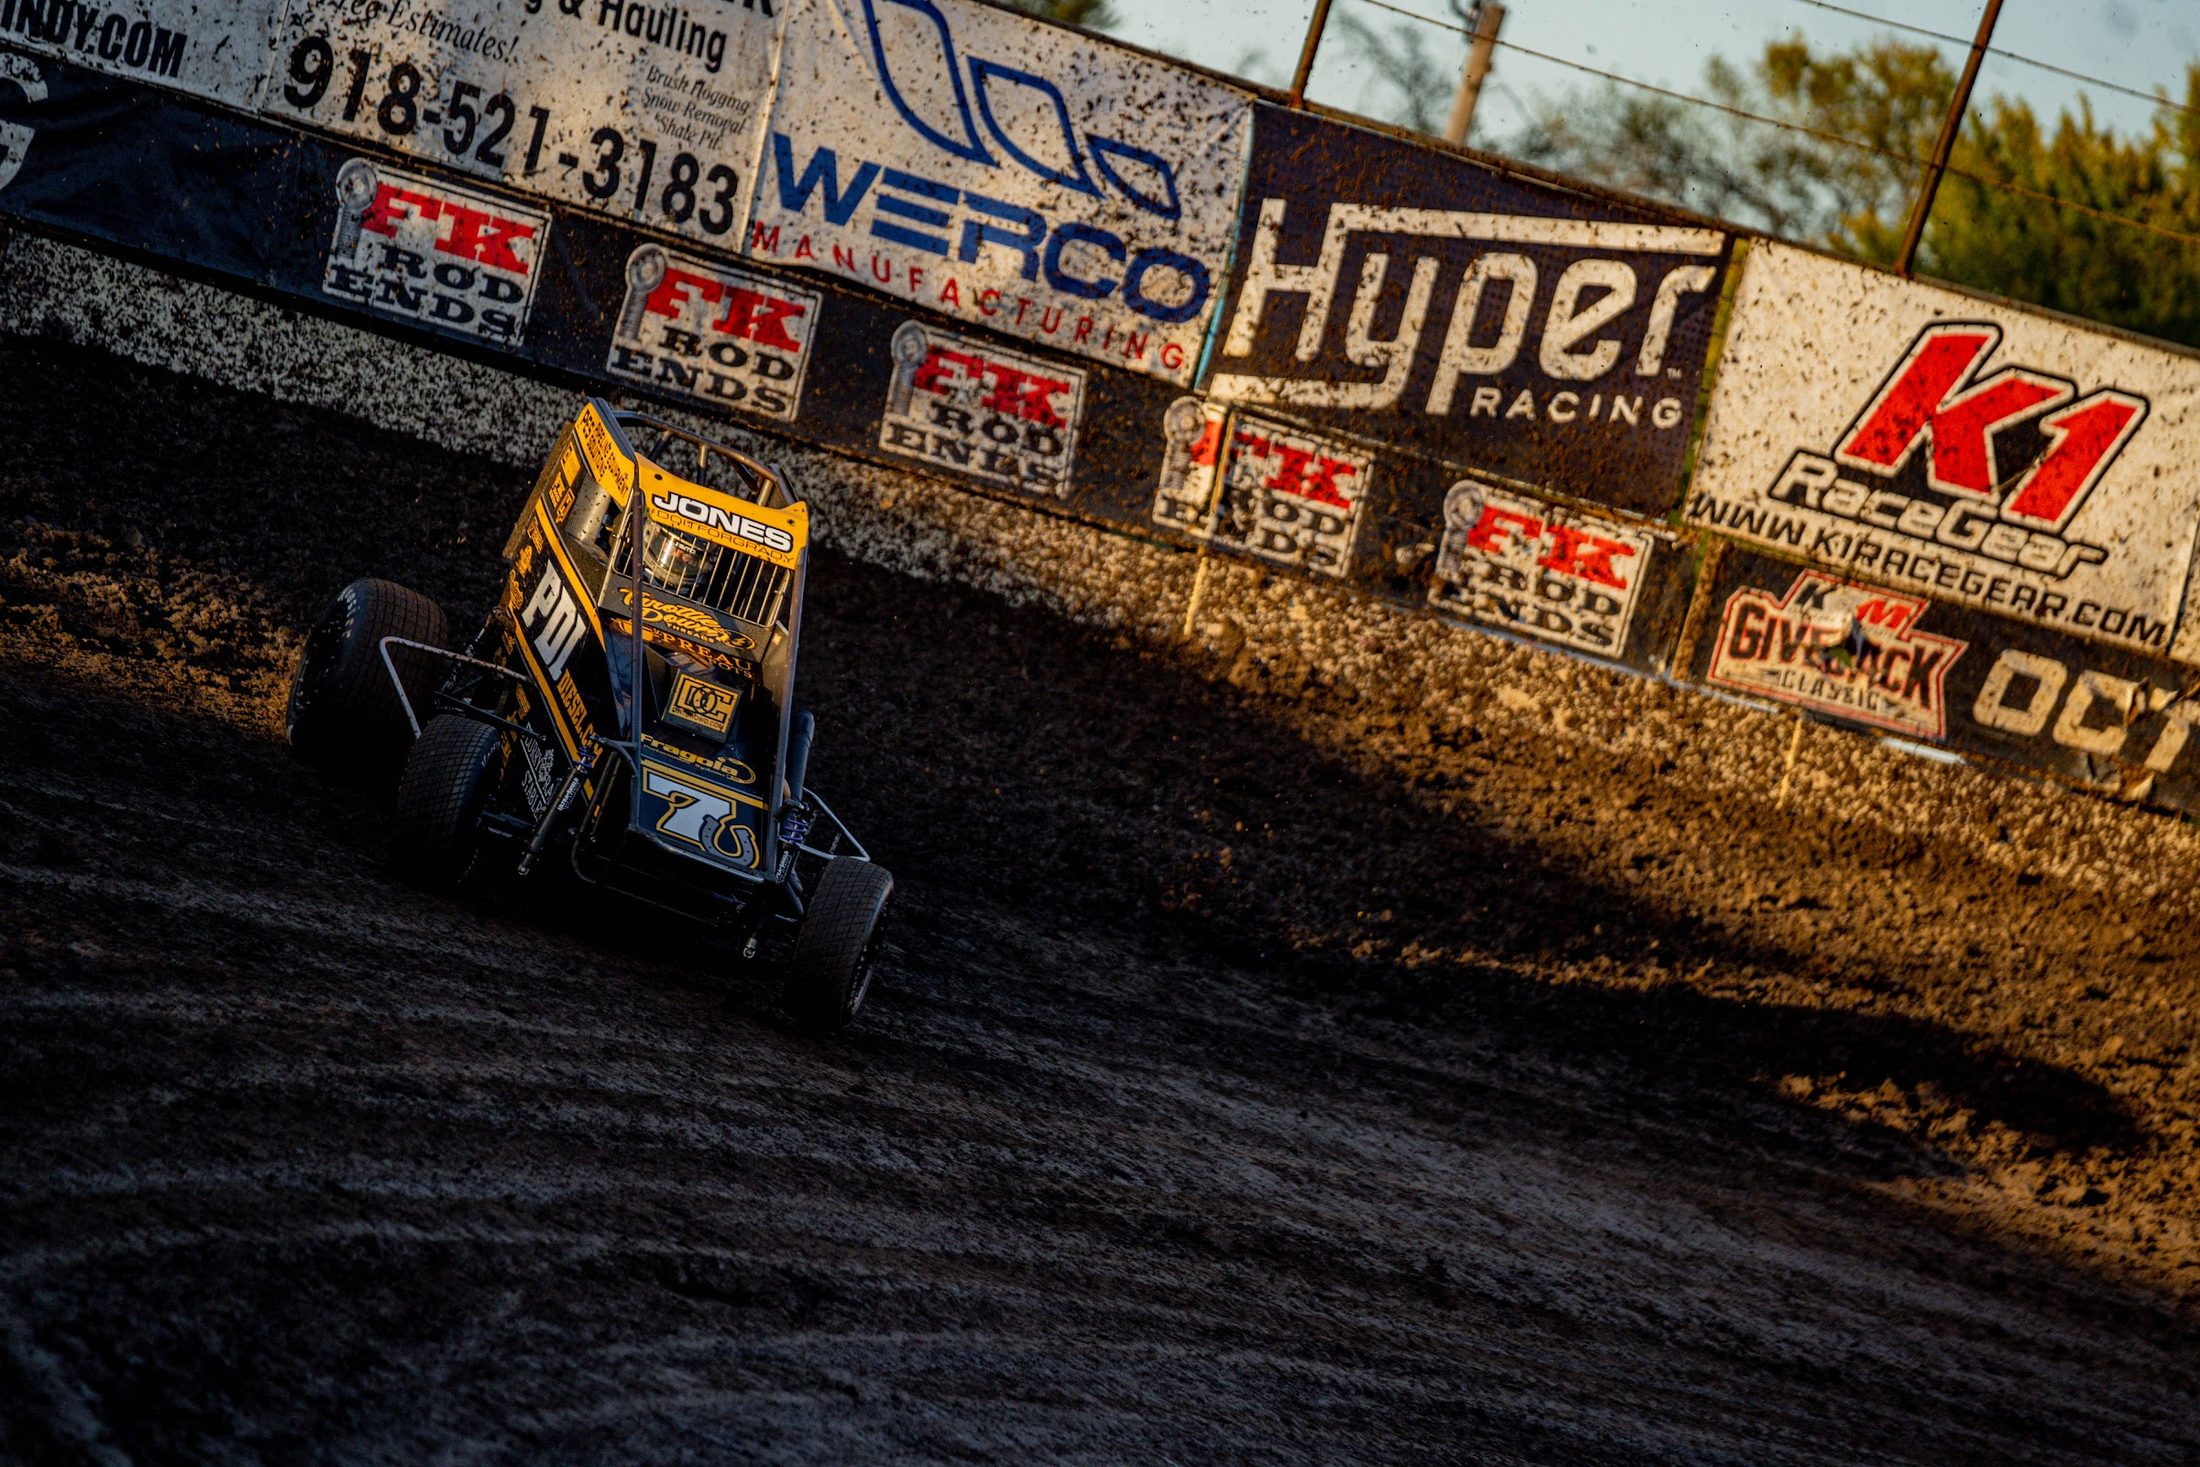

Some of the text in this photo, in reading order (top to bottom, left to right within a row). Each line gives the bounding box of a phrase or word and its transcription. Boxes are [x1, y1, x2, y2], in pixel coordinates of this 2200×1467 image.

[597, 0, 727, 73] Hauling
[283, 36, 738, 236] 918-521-3183
[360, 182, 536, 276] FK
[773, 132, 1210, 324] WERCO
[328, 263, 516, 336] ENDS
[378, 243, 524, 304] ROD
[645, 267, 807, 353] FK
[750, 221, 1185, 372] MANUFACTURING
[1210, 198, 1726, 415] Hyper
[611, 344, 792, 413] ENDS
[658, 326, 795, 382] ROD
[914, 344, 1071, 430] FK
[1470, 386, 1685, 430] RACING
[1833, 322, 2149, 532] K1
[652, 491, 793, 553] JONES
[1157, 493, 1338, 568] EDS
[1228, 483, 1345, 535] OD
[1467, 506, 1636, 590] FK
[1767, 448, 2109, 581] RaceGear
[1440, 583, 1613, 647] NDS
[1728, 602, 1943, 712] GIVEACK
[640, 731, 739, 778] Fragola
